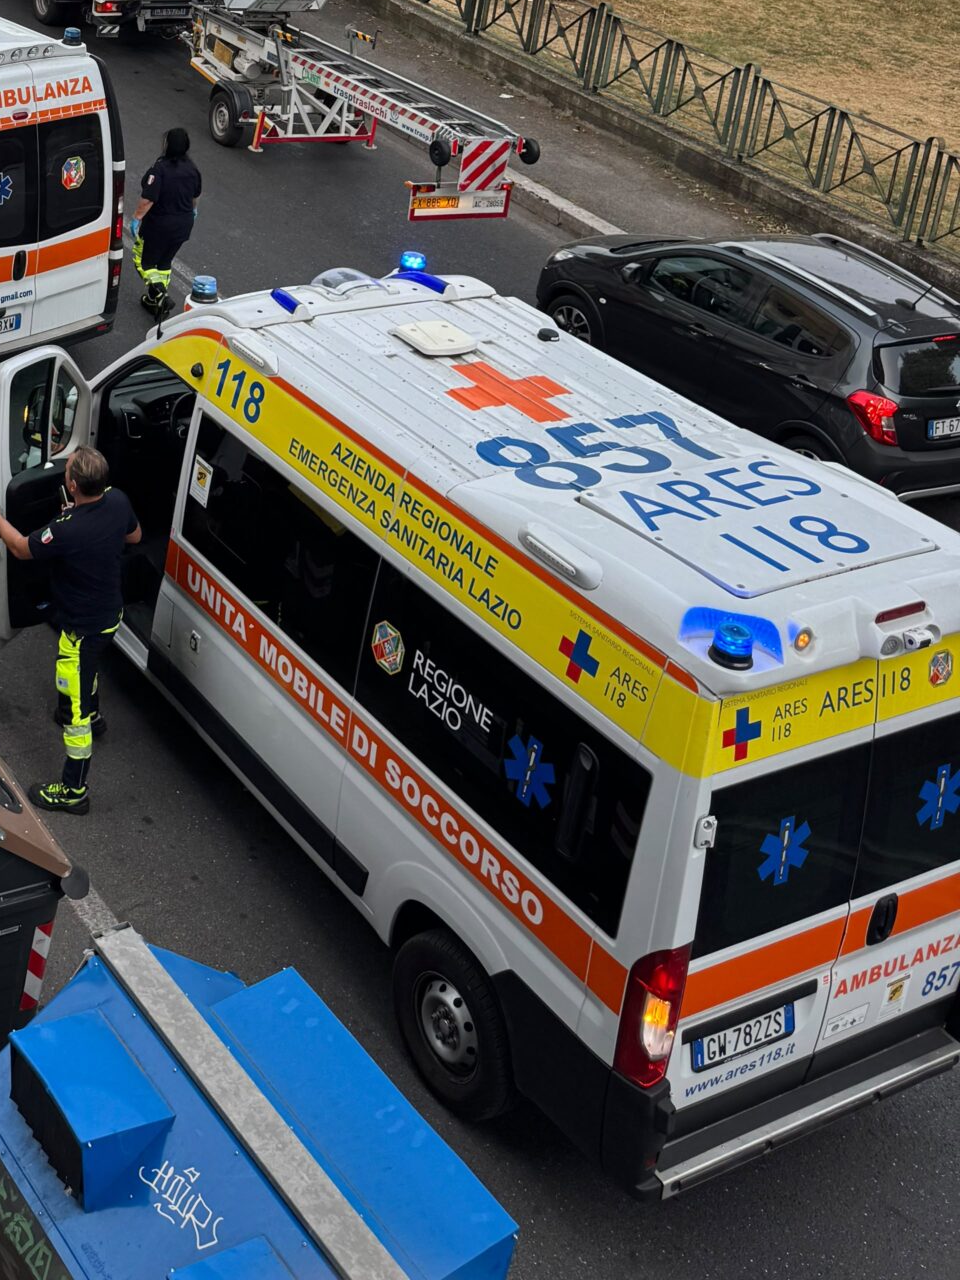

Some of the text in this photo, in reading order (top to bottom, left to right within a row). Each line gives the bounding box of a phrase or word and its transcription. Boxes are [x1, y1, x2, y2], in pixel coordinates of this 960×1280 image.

[333, 85, 388, 119] trasptraslochi
[216, 358, 265, 423] 118
[476, 411, 724, 491] 857
[331, 442, 498, 578] AZIENDA REGIONALE
[619, 460, 823, 532] ARES
[289, 438, 522, 631] EMERGENZA SANITARIA LAZIO
[720, 516, 870, 572] 118
[408, 672, 462, 732] LAZIO
[413, 649, 494, 733] REGIONE
[603, 682, 626, 708] 118
[609, 666, 649, 703] ARES
[722, 695, 746, 710] SISTEMA
[773, 698, 808, 722] ARES
[819, 667, 911, 718] ARES 118
[772, 723, 792, 742] 118
[259, 634, 345, 738] MOBILE
[352, 723, 377, 768] DI
[385, 758, 544, 926] SOCCORSO
[921, 962, 960, 998] 857
[706, 1011, 783, 1061] GW 782ZS
[684, 1042, 796, 1099] www.ares118.it
